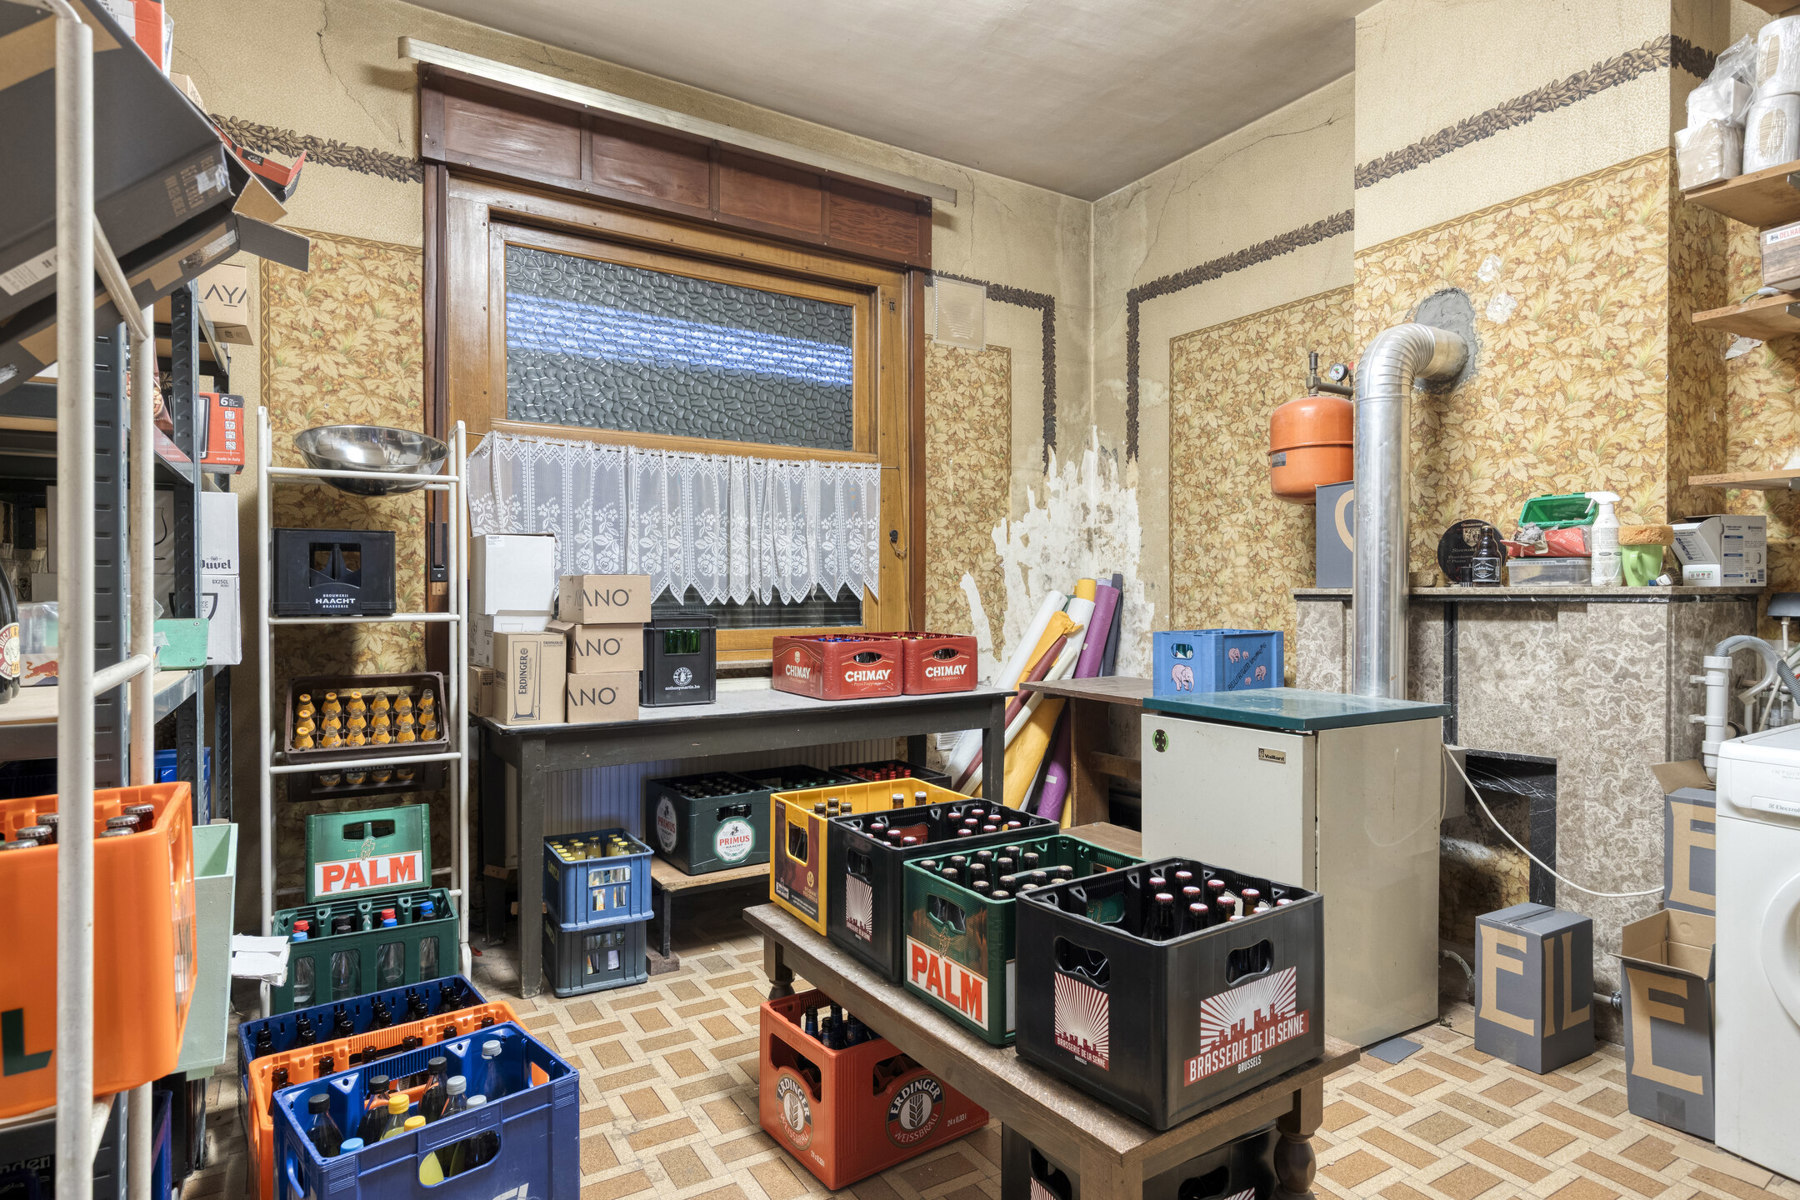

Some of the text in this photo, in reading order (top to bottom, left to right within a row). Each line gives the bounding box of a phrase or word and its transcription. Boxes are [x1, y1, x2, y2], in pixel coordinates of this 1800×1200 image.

[220, 397, 229, 406] 6
[518, 655, 529, 695] ERDINGER
[785, 663, 811, 680] CHIMAY
[844, 668, 892, 683] CHIMAY
[924, 664, 968, 678] CHIMAY
[657, 815, 676, 833] PRIMUS
[719, 835, 750, 846] PRIMUS
[321, 855, 417, 893] PALM
[911, 943, 983, 1024] PALM
[1189, 1014, 1305, 1082] BRASSERIE DE LA SENNE
[1237, 1055, 1262, 1074] BRUSSELS
[777, 1078, 811, 1117] ERDINGER
[890, 1078, 941, 1115] ERDINGER
